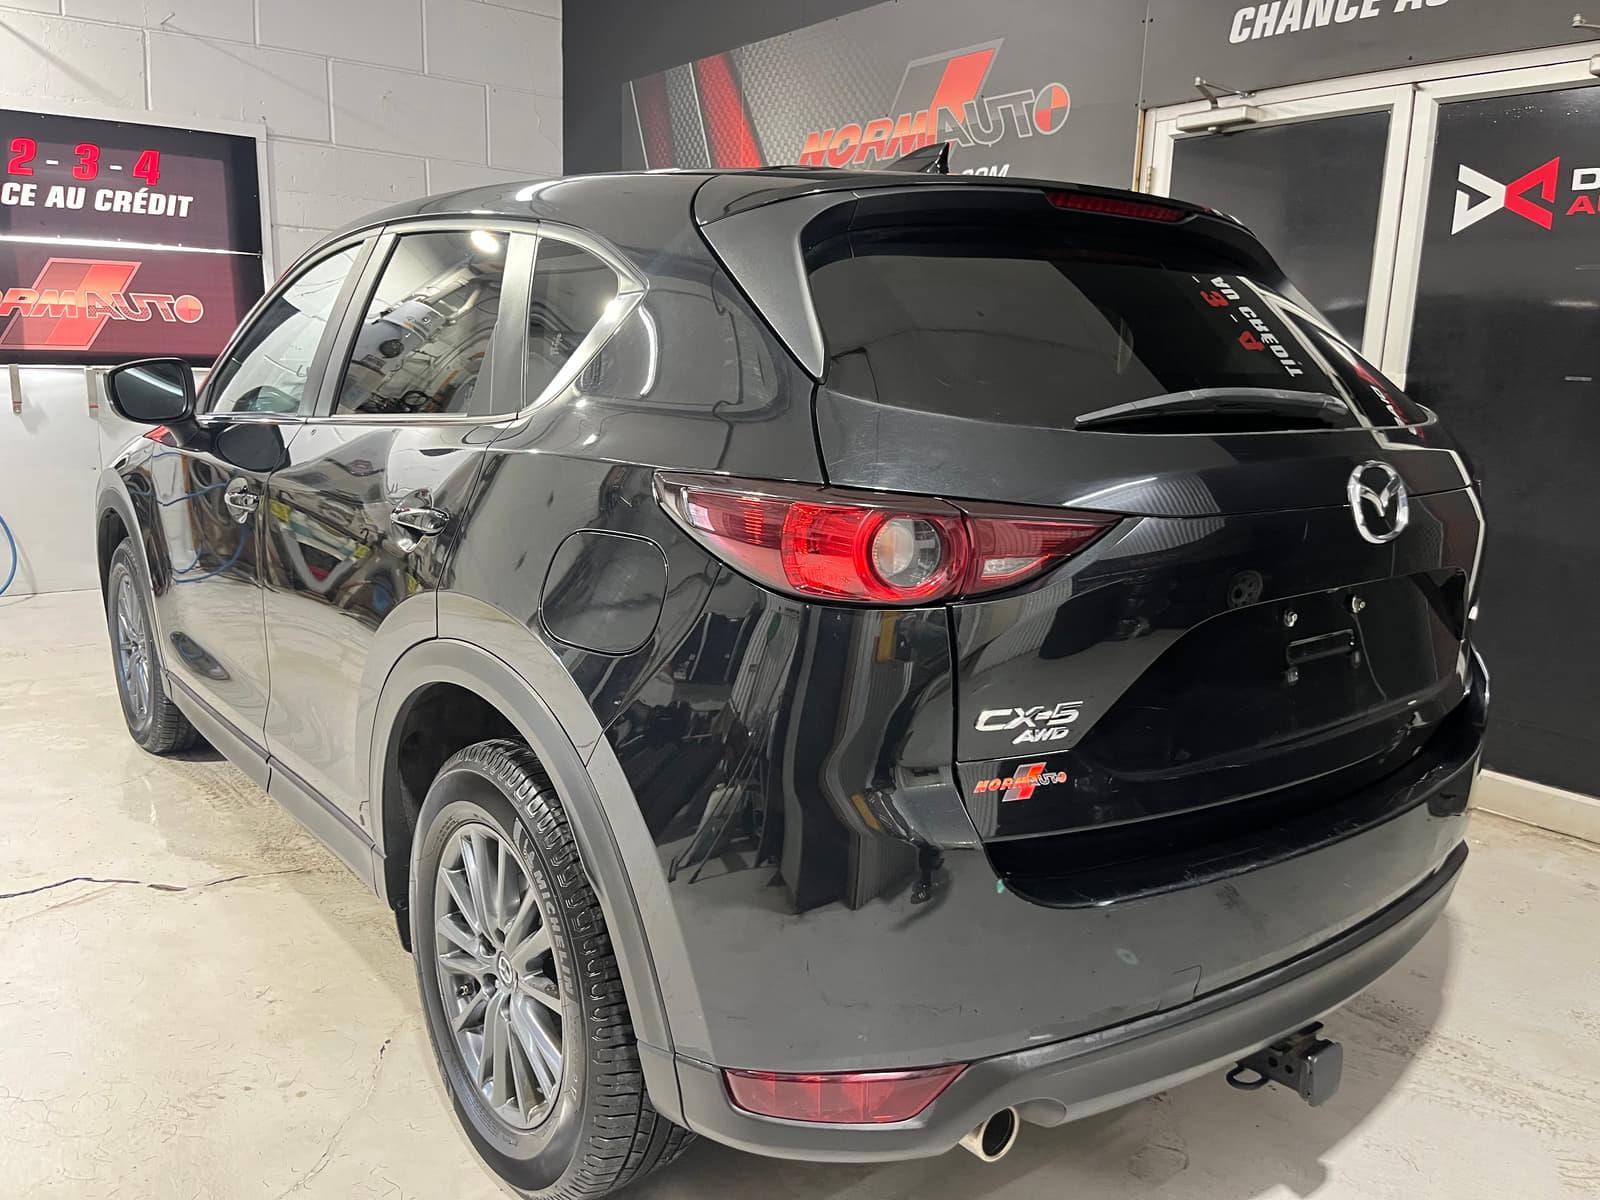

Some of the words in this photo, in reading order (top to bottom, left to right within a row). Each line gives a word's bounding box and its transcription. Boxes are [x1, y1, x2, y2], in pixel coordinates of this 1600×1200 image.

[799, 82, 1071, 167] NORMAUTO
[8, 137, 37, 176] 2
[72, 143, 100, 180] 3
[132, 149, 161, 186] 4
[44, 185, 87, 210] AU
[94, 187, 194, 218] CRÉDIT
[1566, 195, 1600, 216] A
[0, 286, 204, 323] RMAUTO
[974, 700, 1084, 732] CX-5
[1011, 726, 1070, 745] AWD
[973, 771, 1068, 794] NORMAUTO
[533, 869, 575, 995] MICHELIN
